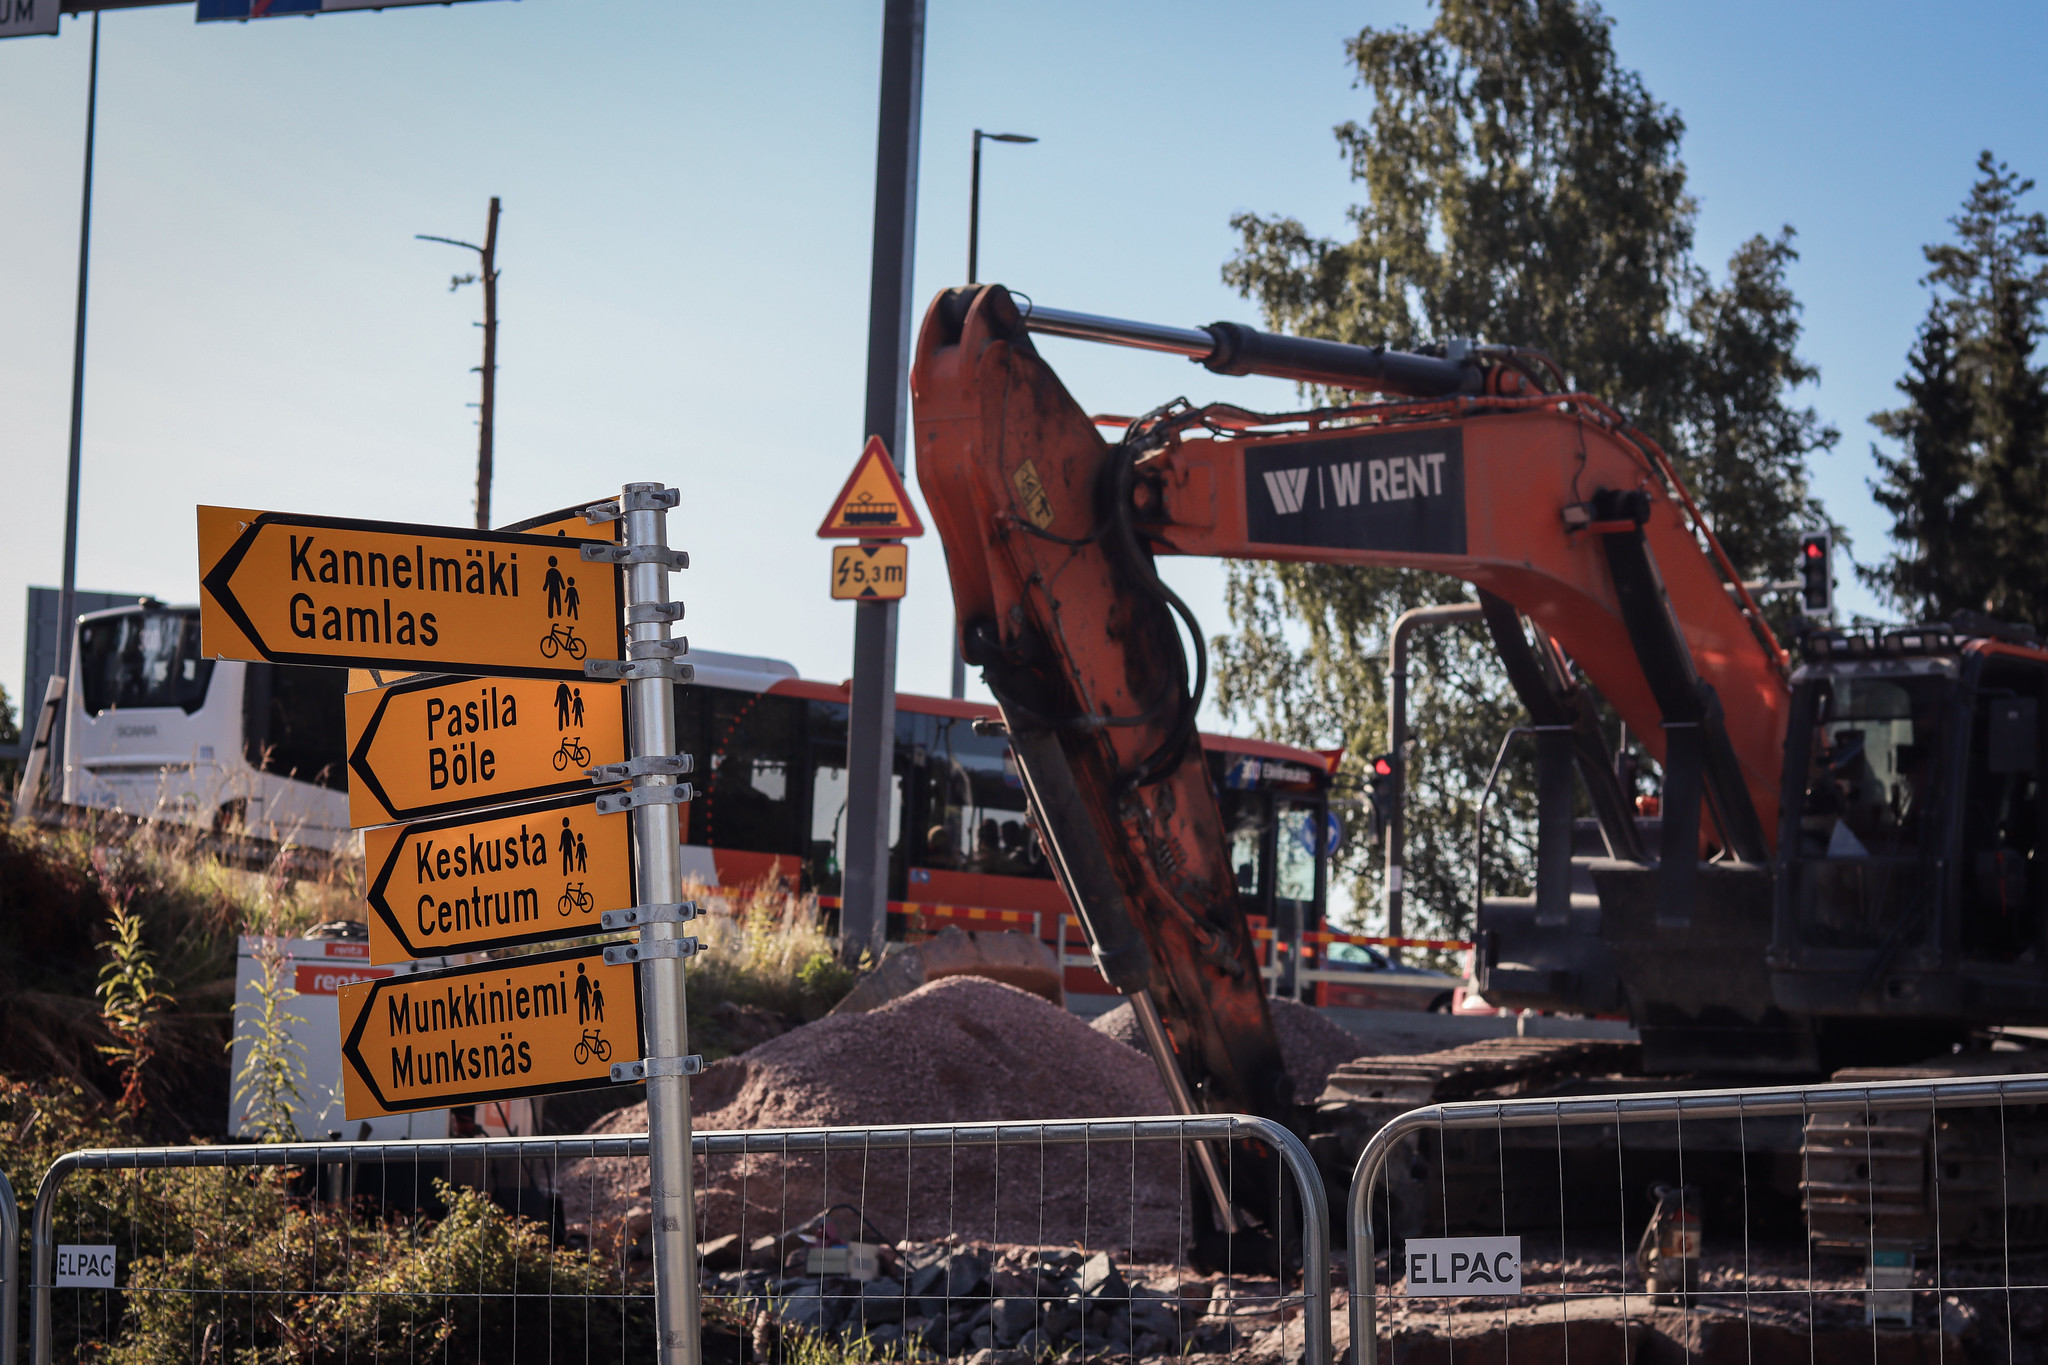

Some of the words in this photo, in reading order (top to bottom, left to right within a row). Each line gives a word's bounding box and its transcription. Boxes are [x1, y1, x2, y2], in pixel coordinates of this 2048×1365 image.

[1330, 461, 1362, 507] W
[1368, 453, 1446, 503] RENT
[289, 534, 520, 598] Kannelmäki
[289, 592, 438, 647] Gamlas
[426, 686, 518, 741] Pasila
[429, 742, 496, 791] Böle
[416, 824, 548, 884] Keskusta
[417, 886, 539, 936] Centrum
[334, 946, 363, 955] renta
[388, 970, 568, 1037] Munkkiniemi
[391, 1032, 532, 1089] Munksnäs
[58, 1253, 112, 1277] ELPAC
[1410, 1251, 1514, 1283] ELPAC
